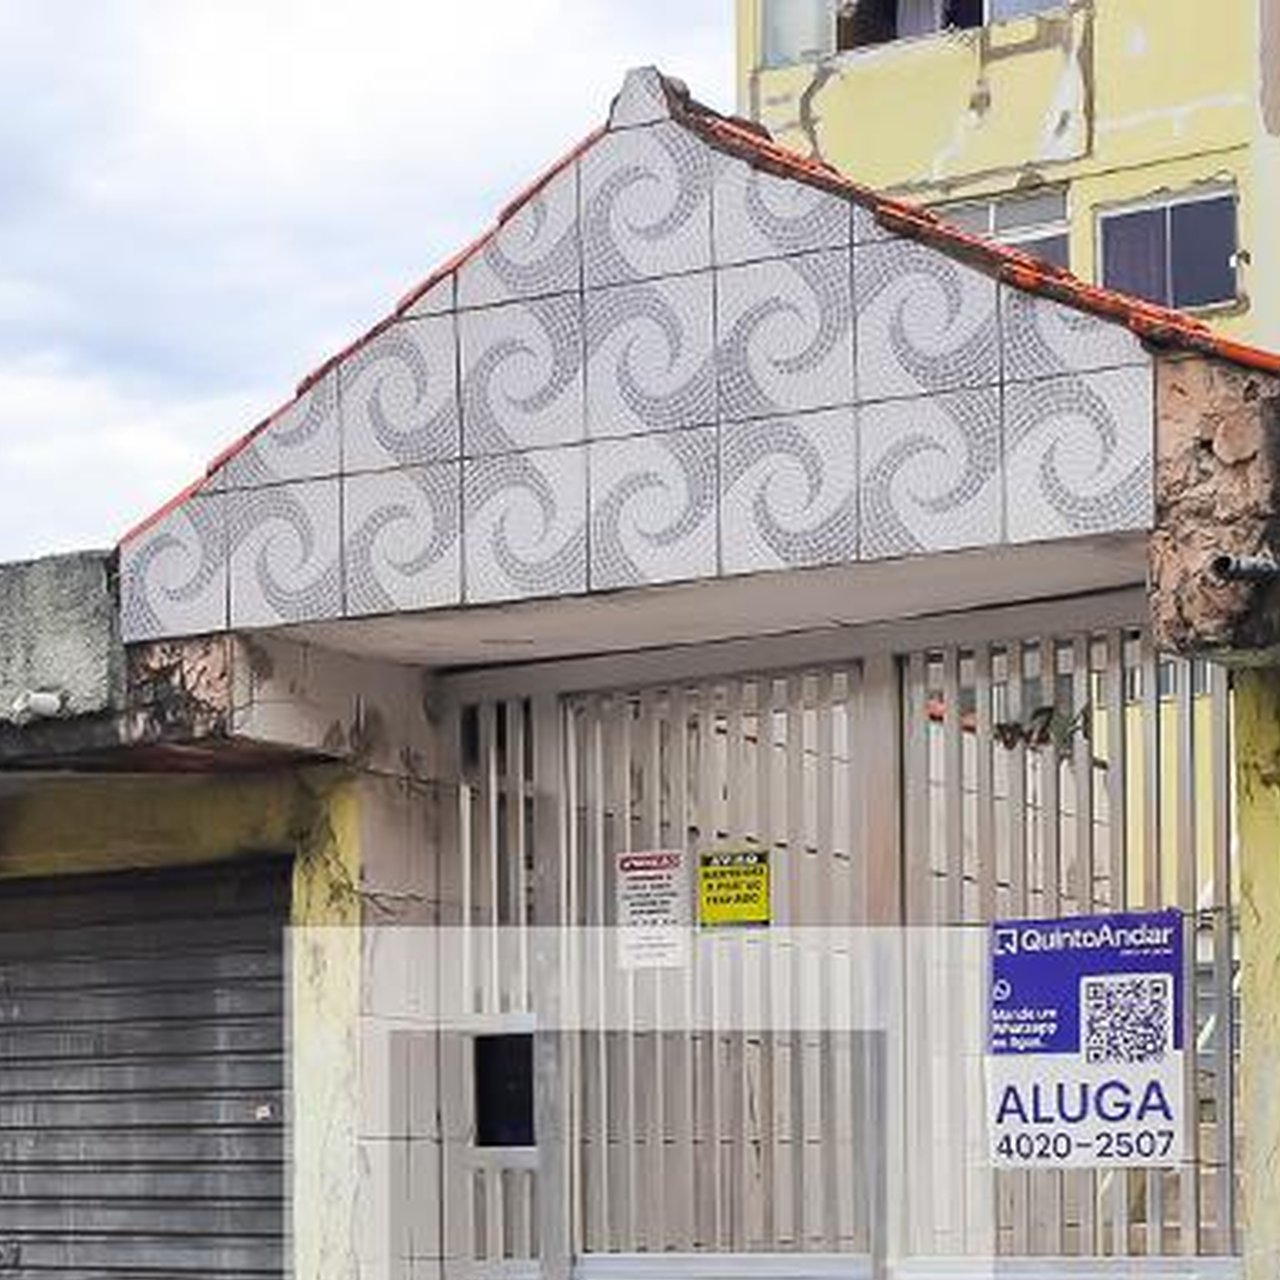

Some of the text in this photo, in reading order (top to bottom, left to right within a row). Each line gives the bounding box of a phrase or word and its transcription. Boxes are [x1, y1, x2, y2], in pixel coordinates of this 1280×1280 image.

[1021, 924, 1174, 950] QuintoAndar
[996, 1080, 1173, 1124] ALUGA
[997, 1130, 1174, 1158] 4020-2507
